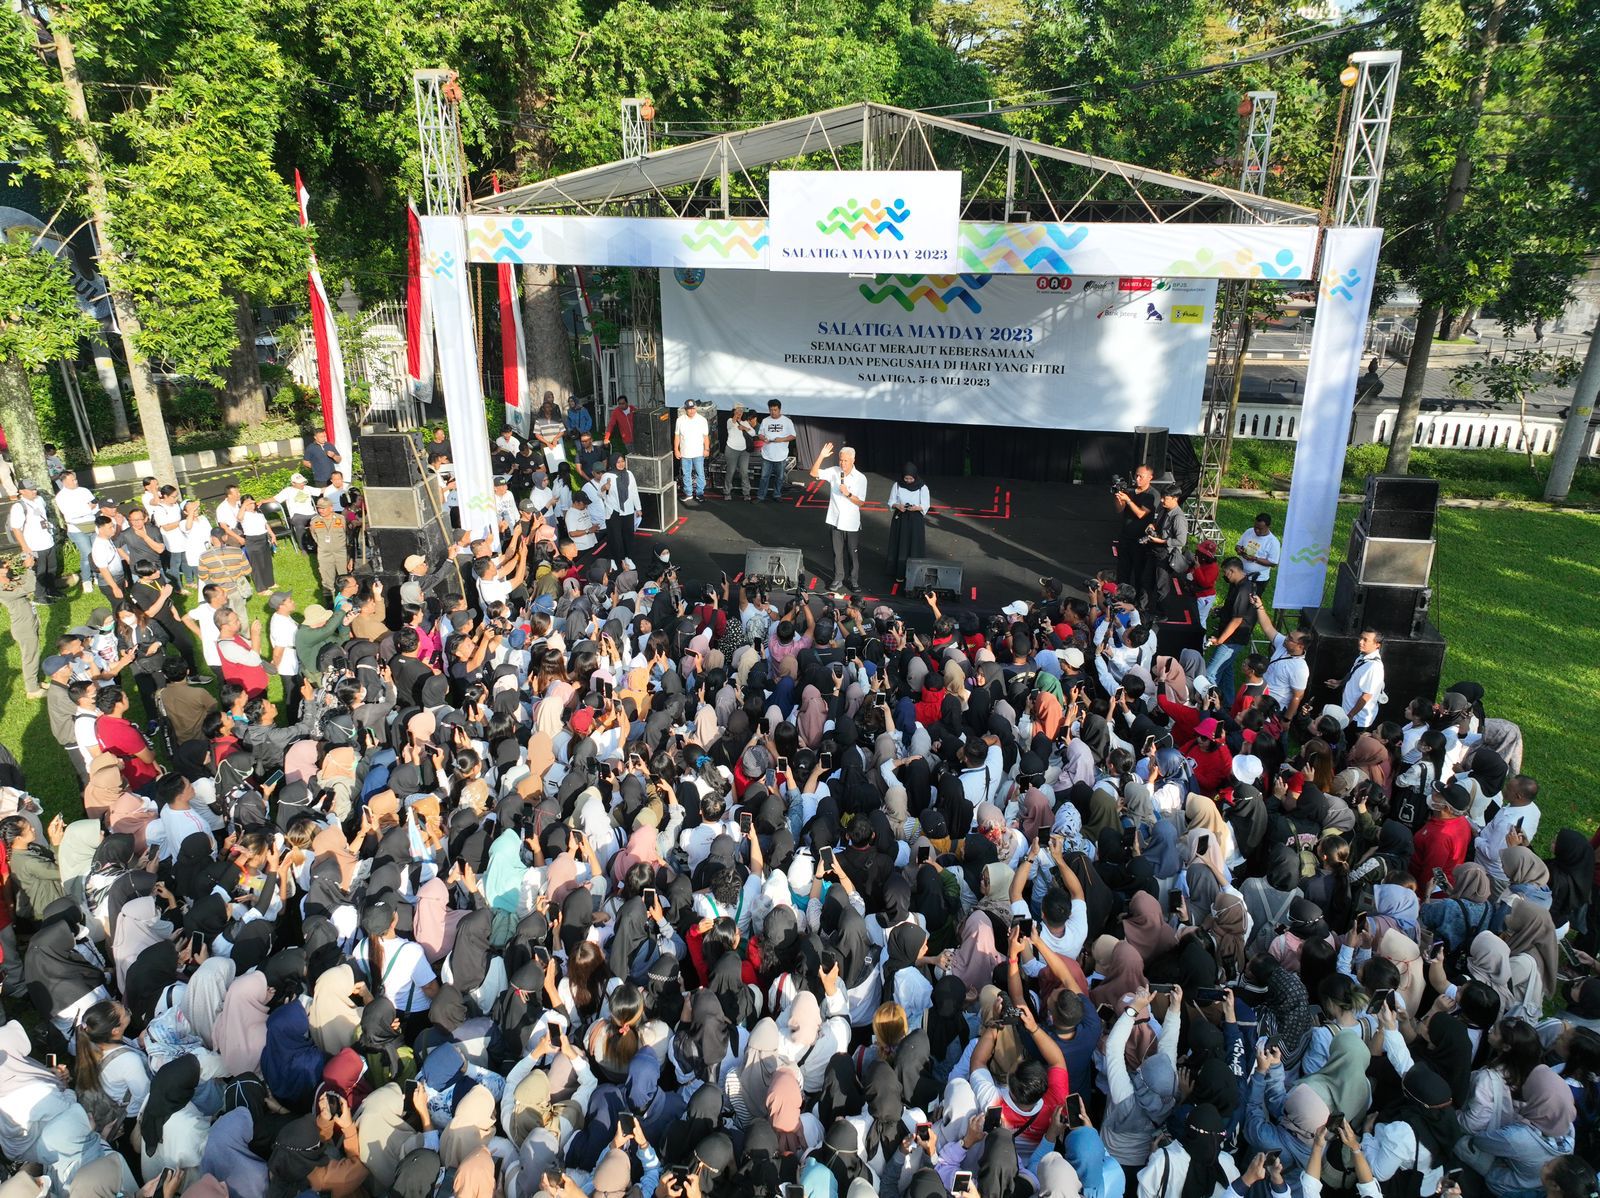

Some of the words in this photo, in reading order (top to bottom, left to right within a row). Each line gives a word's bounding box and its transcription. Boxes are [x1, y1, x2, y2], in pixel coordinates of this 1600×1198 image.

[782, 247, 848, 259] SALATIGA
[852, 248, 910, 260] MAYDAY
[914, 249, 948, 260] 2023
[1038, 277, 1070, 289] AAJ
[818, 321, 904, 337] SALATIGA
[908, 324, 986, 340] MAYDAY
[990, 327, 1033, 343] 2023
[810, 341, 876, 353] SEMANGAT
[879, 343, 937, 356] MERAJUT
[939, 346, 1036, 359] KEBERSAMAAN
[784, 353, 835, 365] PEKERJA
[838, 356, 863, 366] DAN
[866, 357, 940, 370] PENGUSAHA
[943, 360, 957, 370] DI
[960, 361, 991, 372] HARI
[995, 362, 1029, 374] YANG
[1031, 364, 1066, 375] FITRI
[857, 373, 916, 384] SALATIGA,
[941, 376, 960, 386] MEI
[963, 377, 990, 387] 2023
